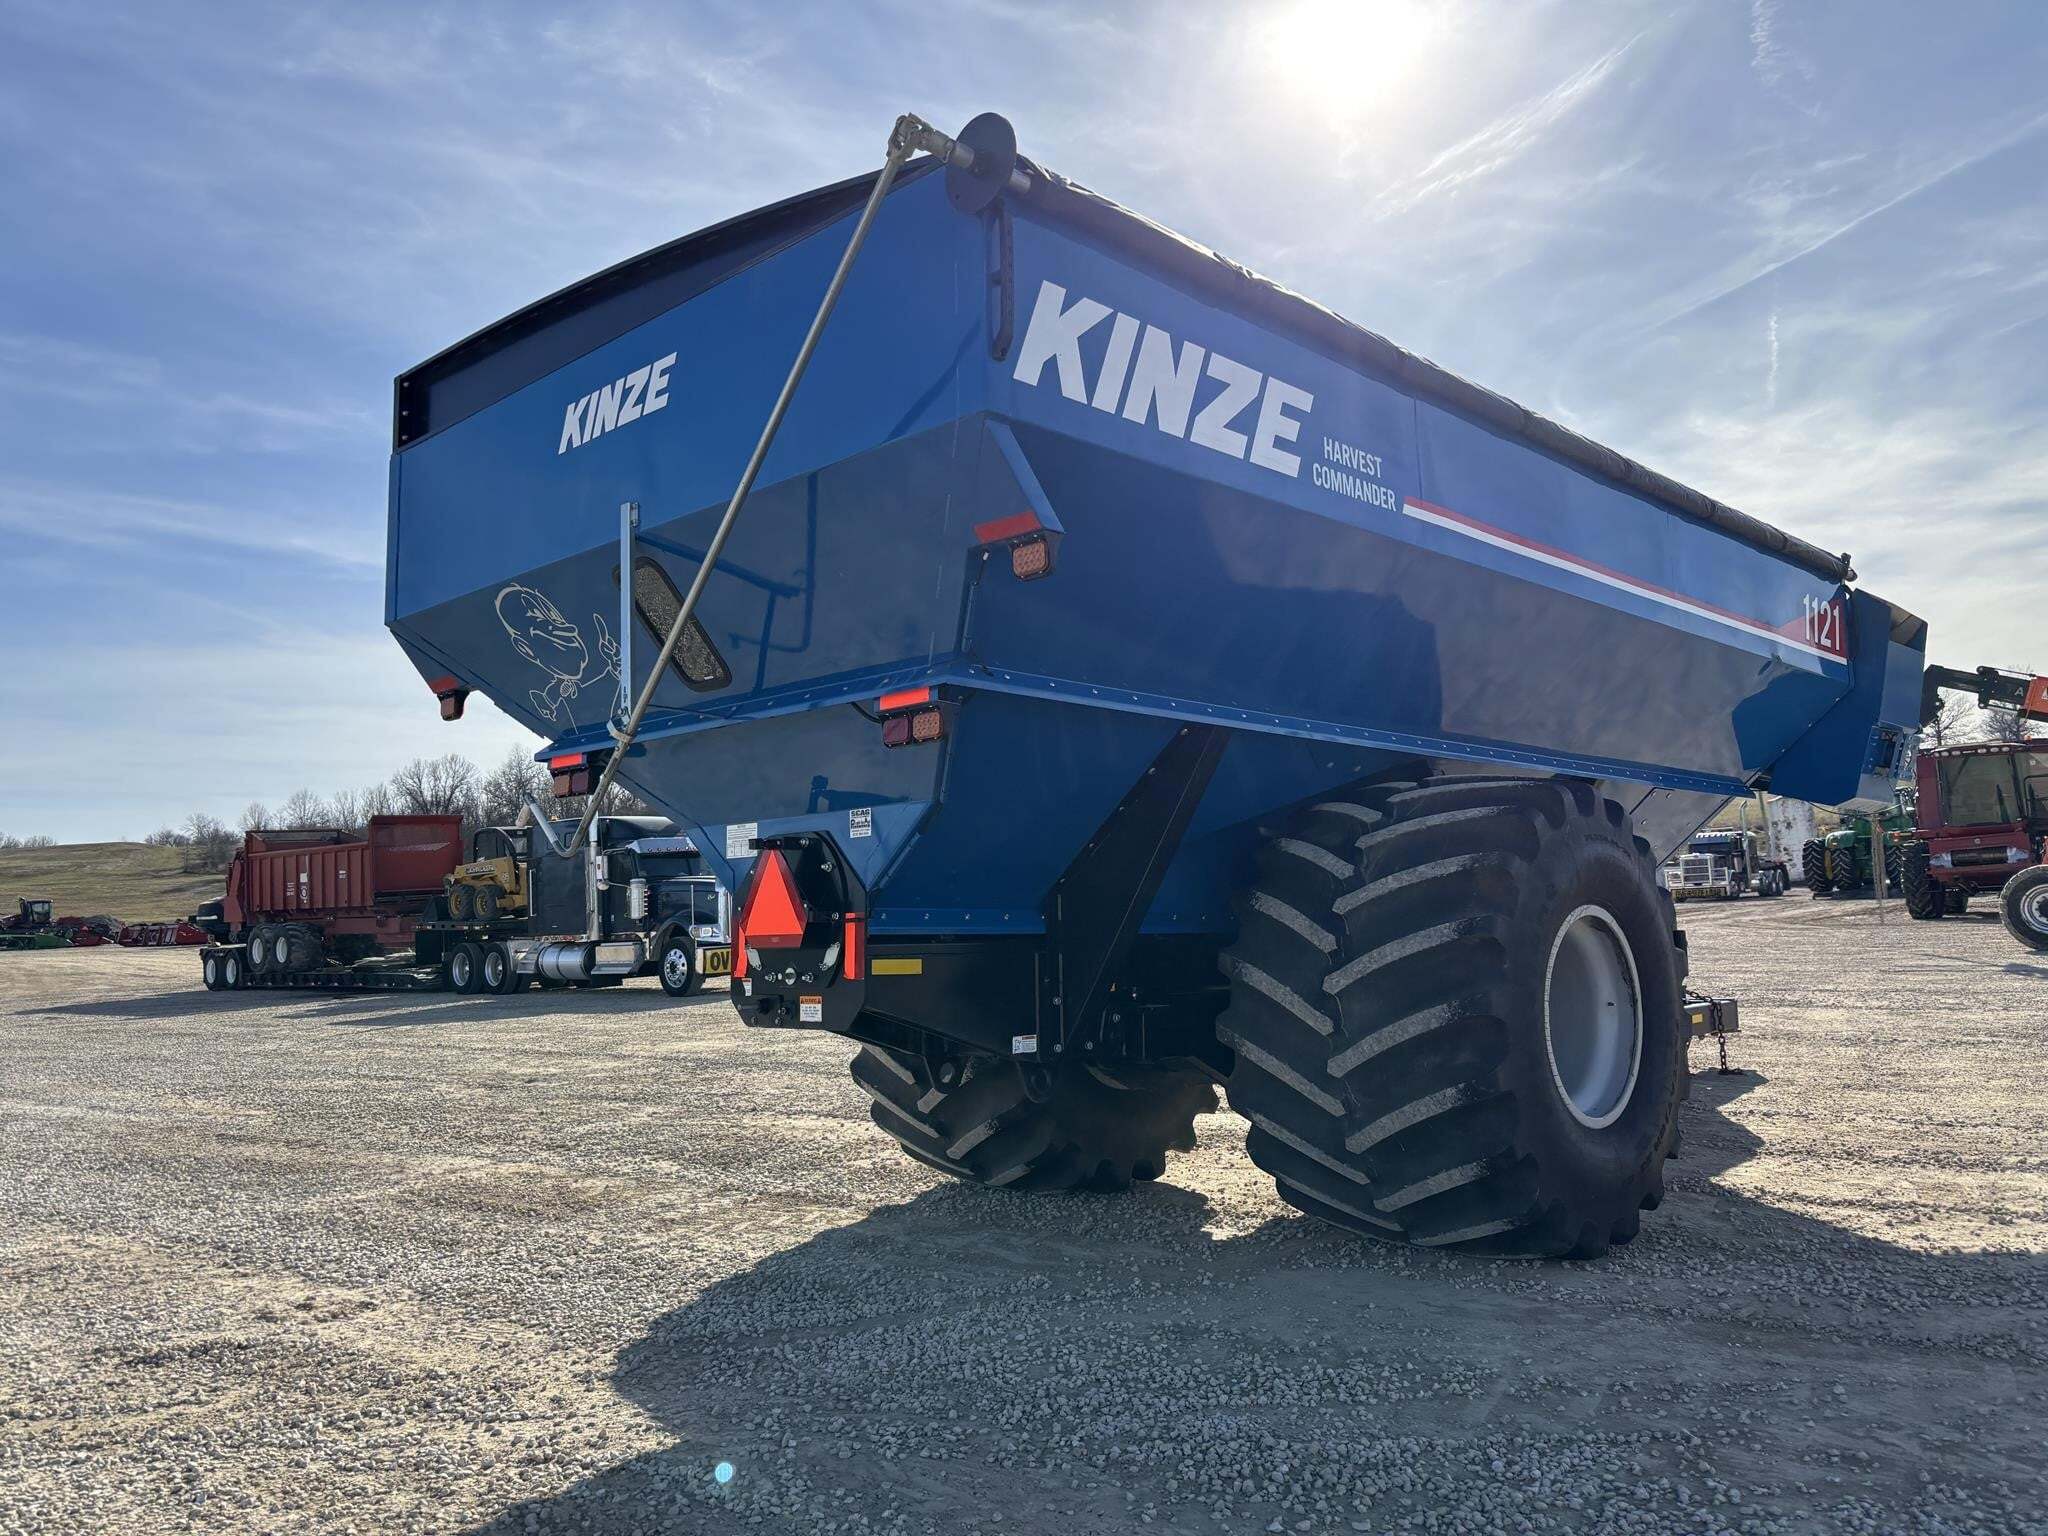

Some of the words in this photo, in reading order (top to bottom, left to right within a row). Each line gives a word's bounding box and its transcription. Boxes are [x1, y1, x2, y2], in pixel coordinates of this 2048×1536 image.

[558, 352, 677, 455] KINZE
[1012, 280, 1314, 478] KINZE
[1323, 436, 1382, 478] HARVEST
[1313, 463, 1397, 512] COMMANDER
[1803, 593, 1840, 650] 1121
